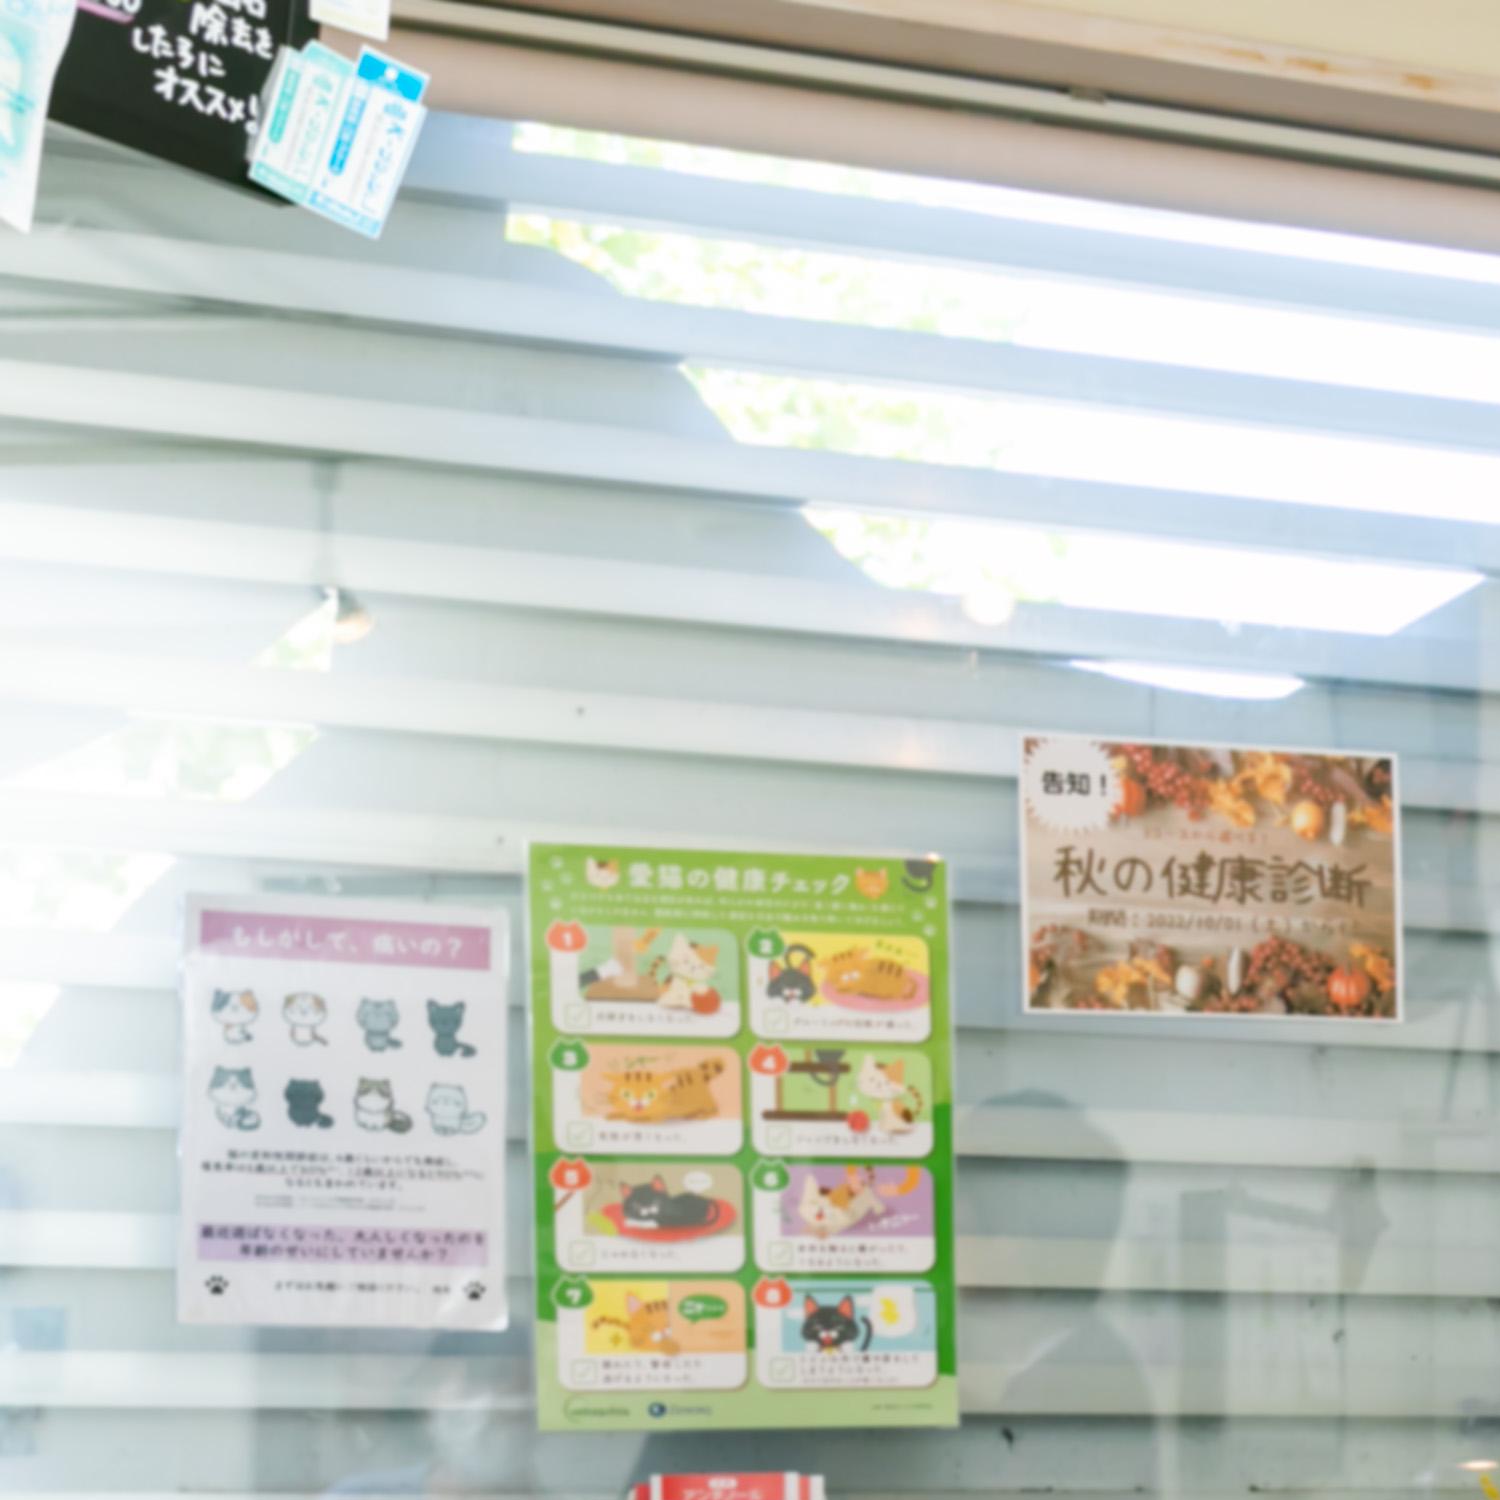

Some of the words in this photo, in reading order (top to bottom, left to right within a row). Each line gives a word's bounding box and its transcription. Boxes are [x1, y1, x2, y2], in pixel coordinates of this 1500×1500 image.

[628, 863, 851, 894] 愛猫の健康チェック
[1052, 844, 1372, 908] 秋の健康診断
[761, 1054, 776, 1071] 4
